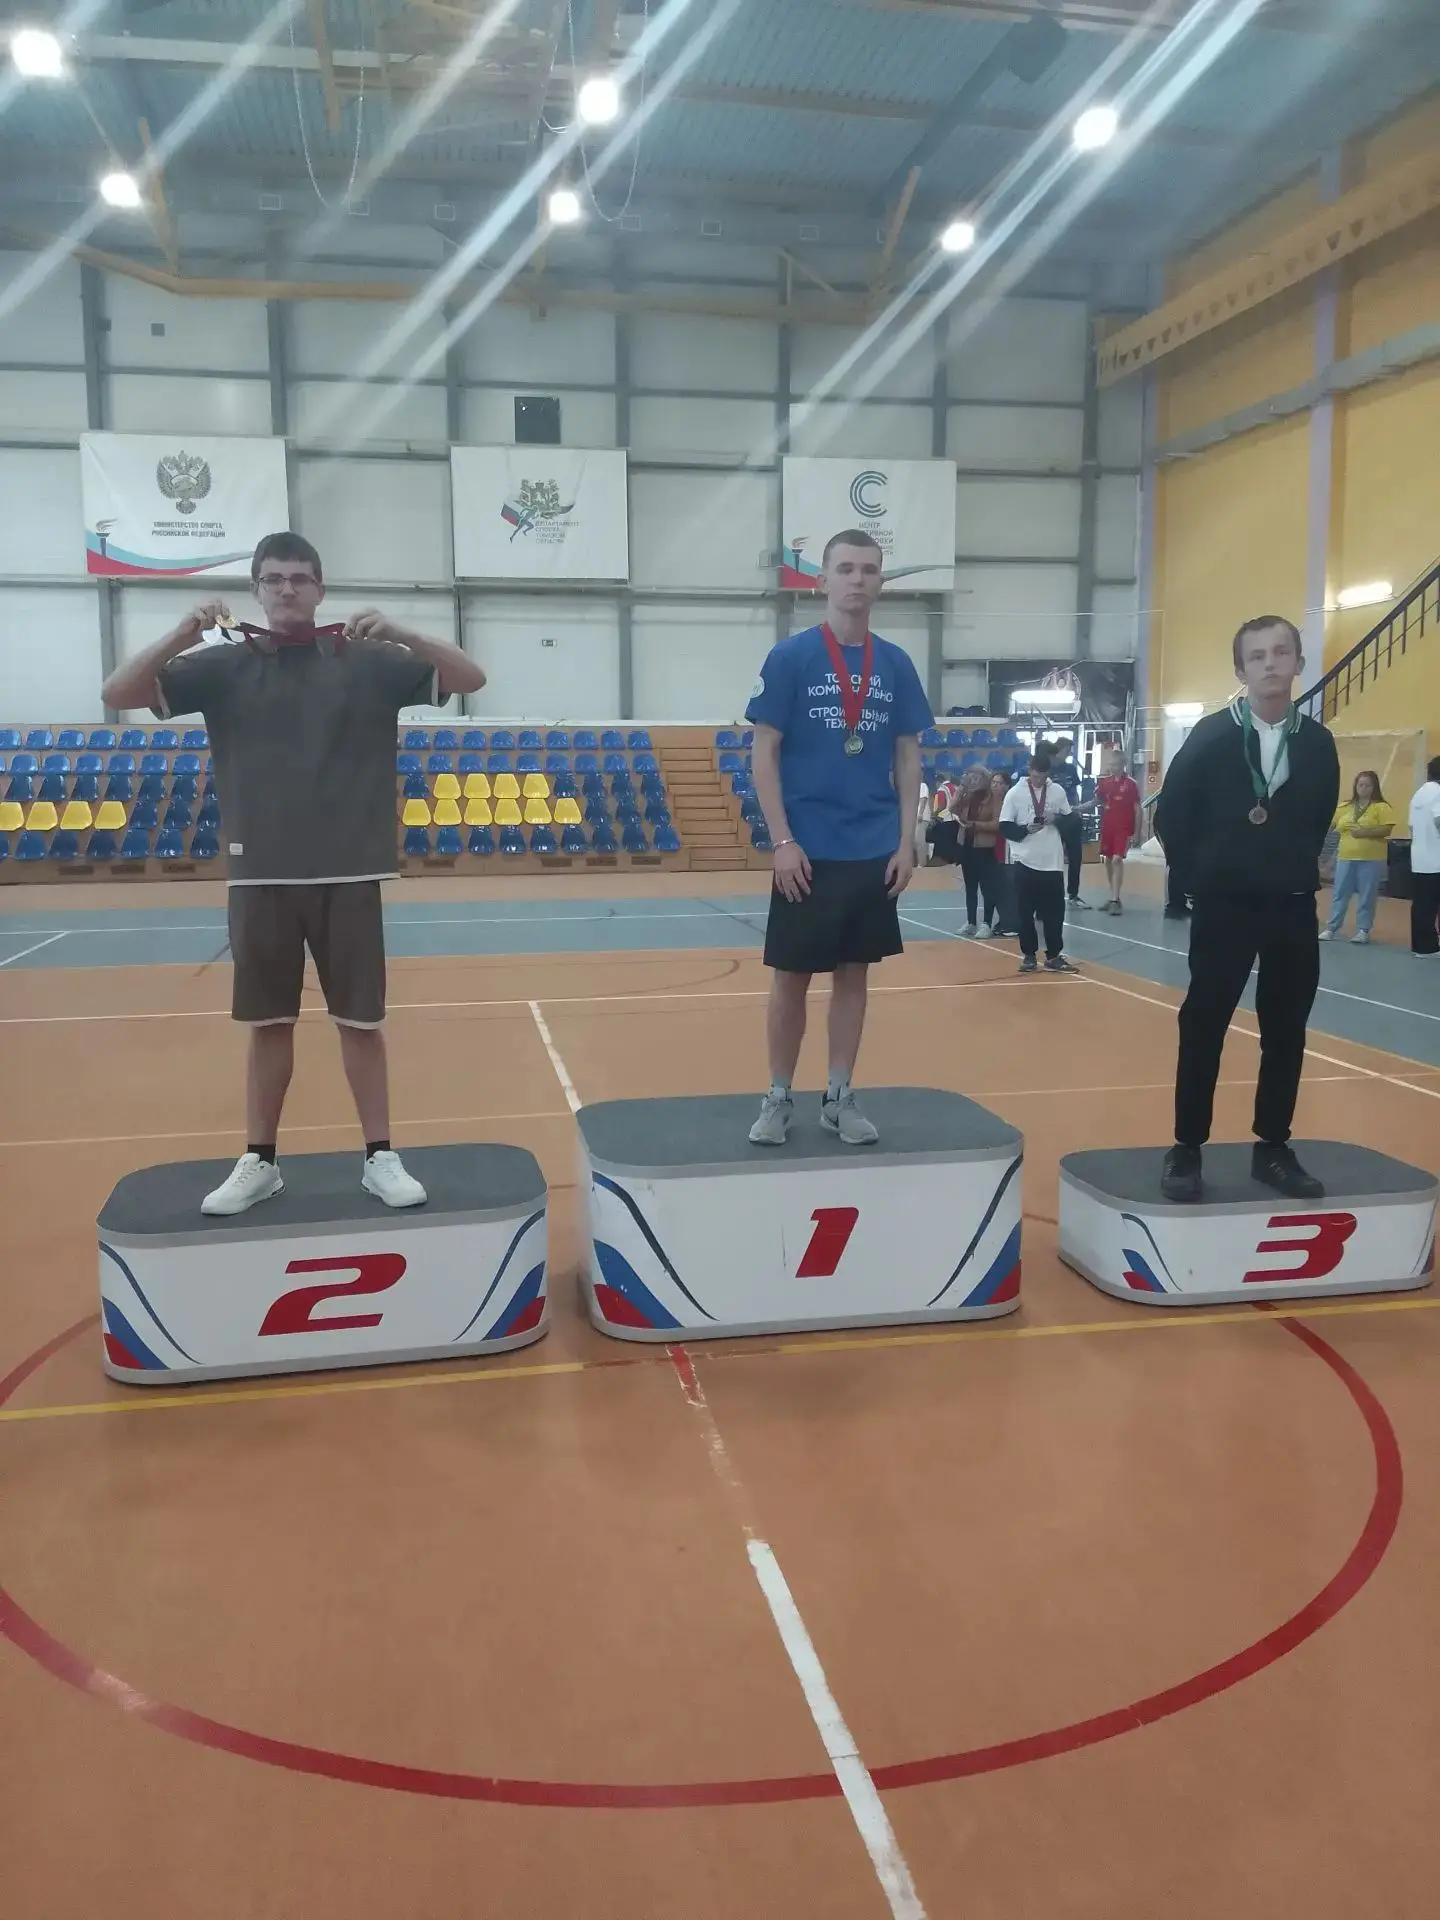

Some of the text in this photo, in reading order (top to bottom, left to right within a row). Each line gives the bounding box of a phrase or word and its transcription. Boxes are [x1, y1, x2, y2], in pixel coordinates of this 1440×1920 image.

[795, 1207, 859, 1279] 1
[1242, 1212, 1357, 1283] 3
[257, 1252, 407, 1336] 2
